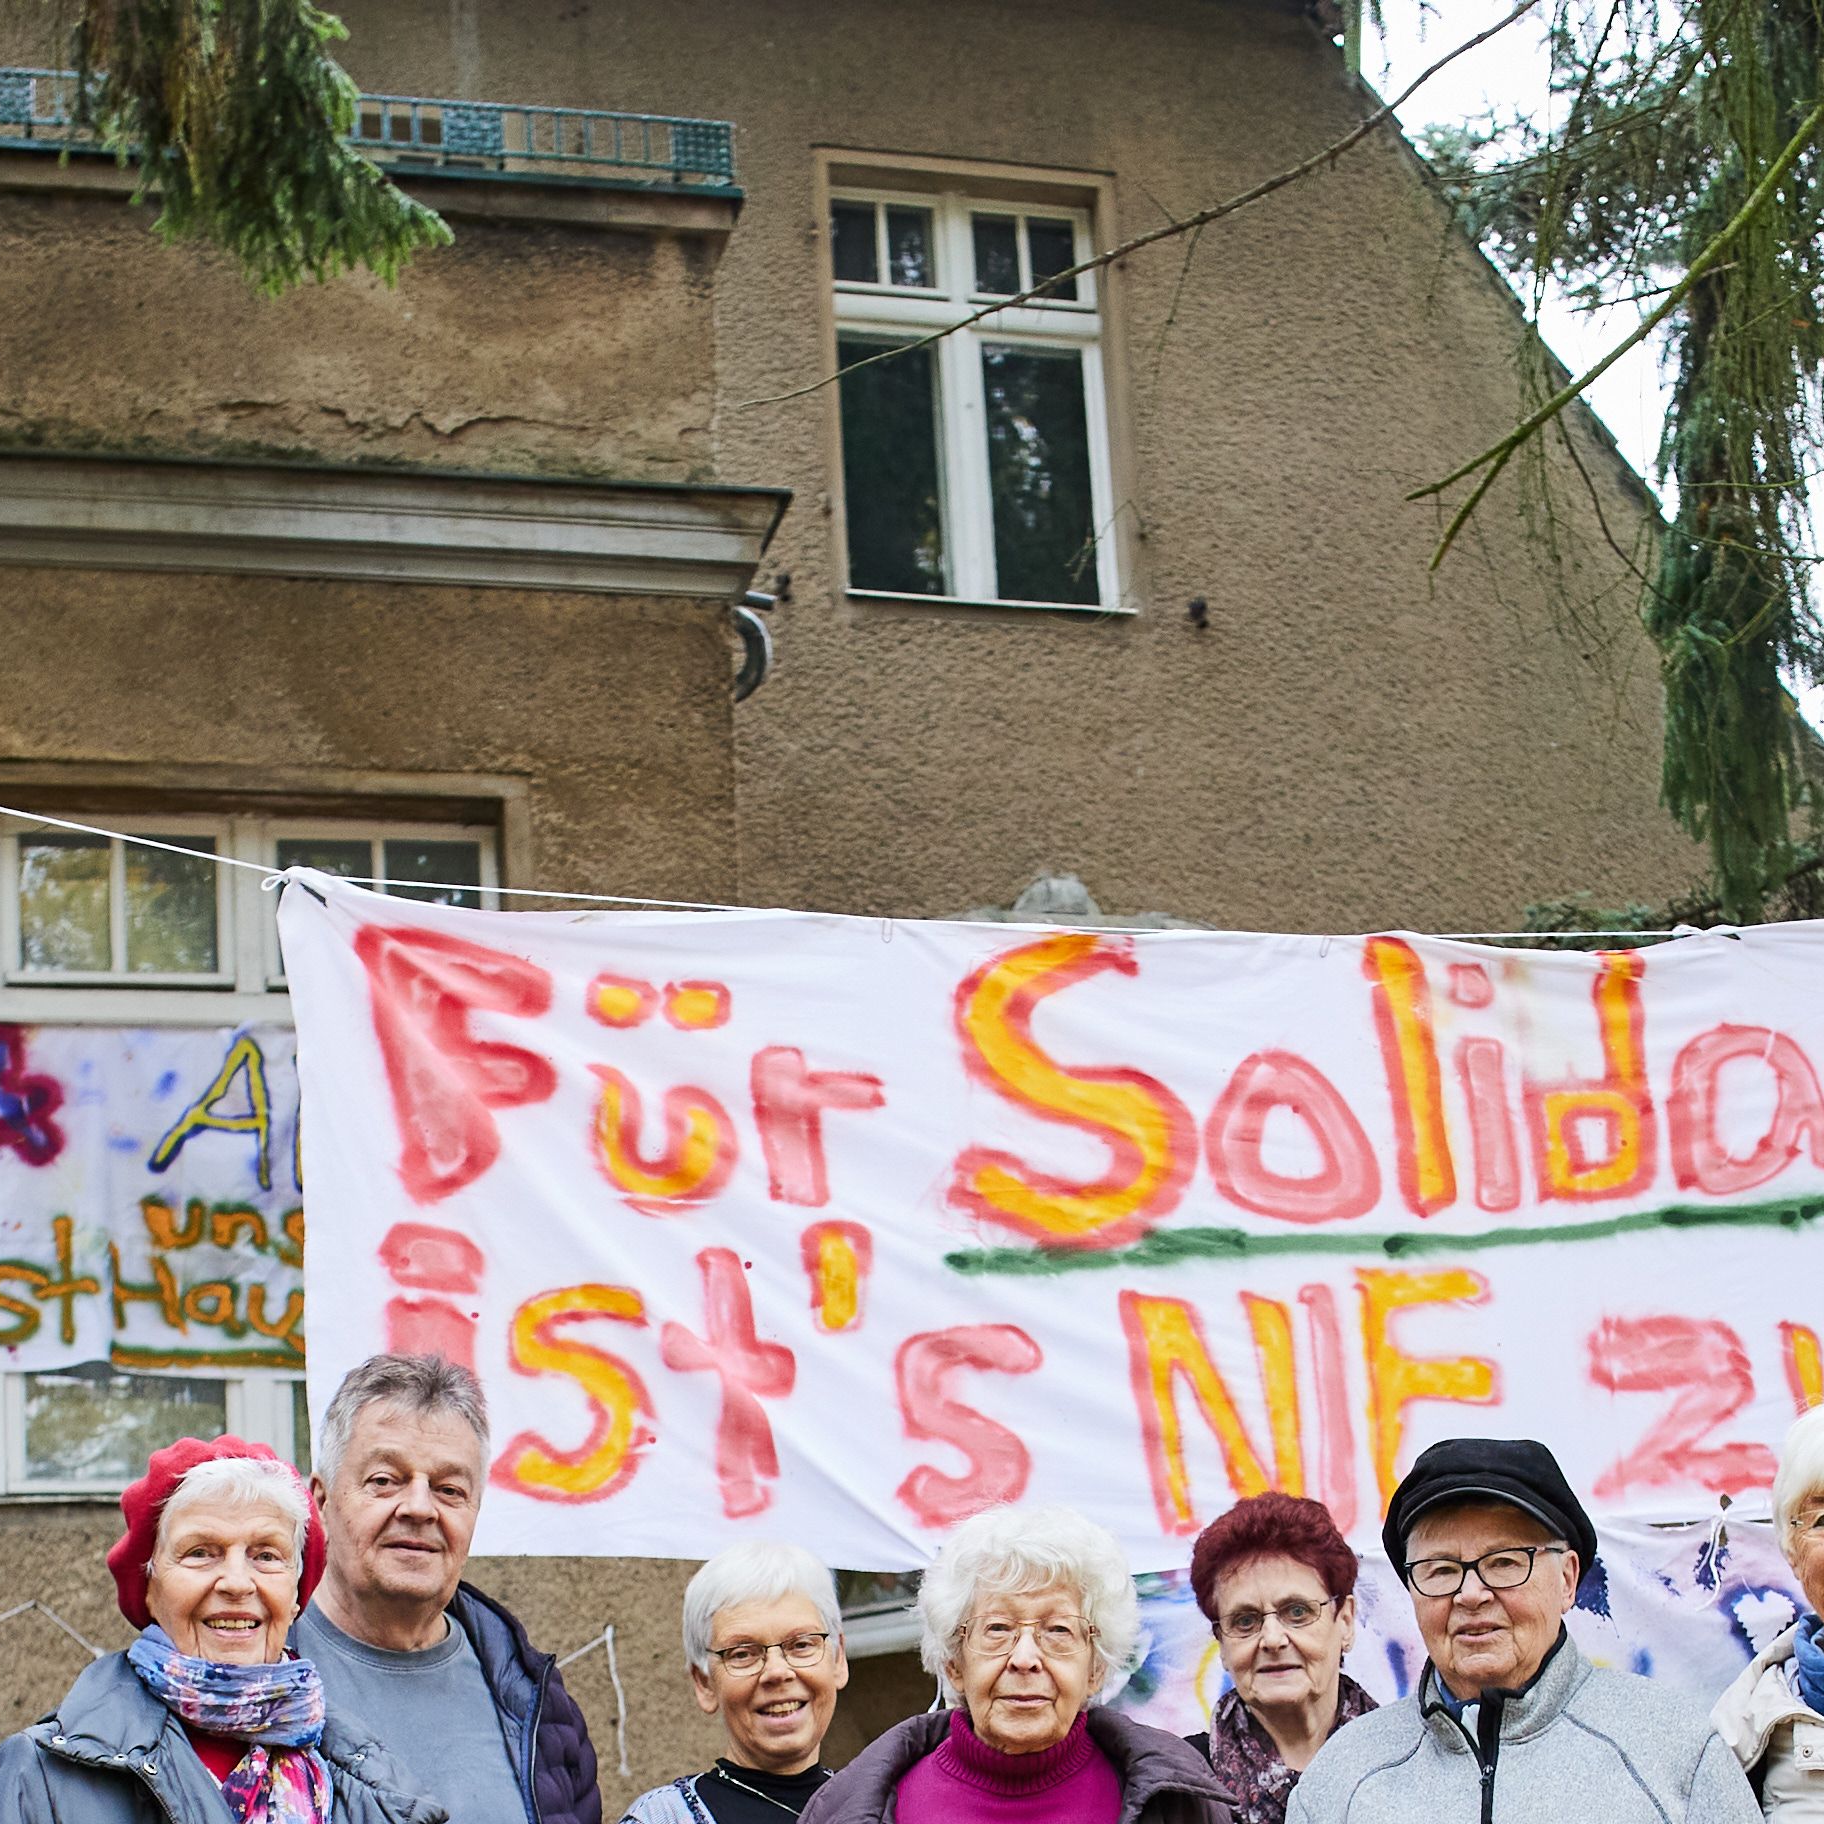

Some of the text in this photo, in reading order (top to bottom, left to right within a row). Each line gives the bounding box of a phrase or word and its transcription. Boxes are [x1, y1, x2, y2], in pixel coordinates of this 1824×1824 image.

[148, 1030, 303, 1192] A
[354, 922, 886, 1215] Für
[108, 1240, 305, 1352] Hau
[378, 1220, 1044, 1528] ist's
[1118, 1265, 1502, 1537] NIE
